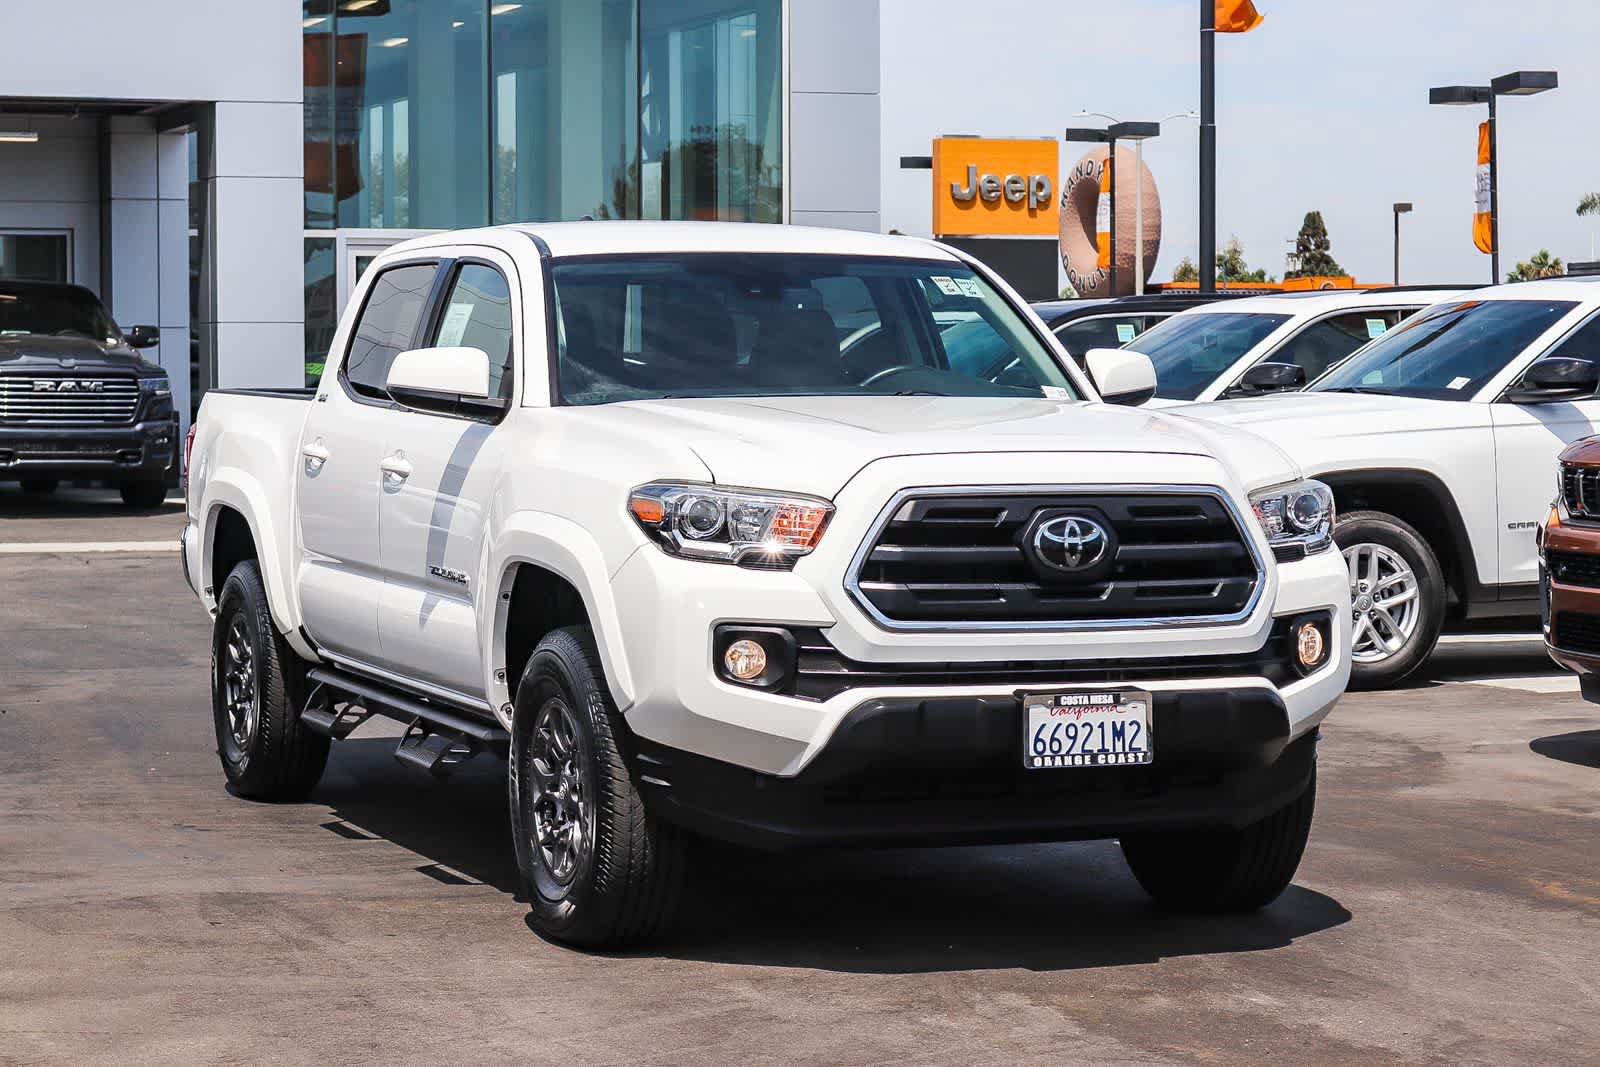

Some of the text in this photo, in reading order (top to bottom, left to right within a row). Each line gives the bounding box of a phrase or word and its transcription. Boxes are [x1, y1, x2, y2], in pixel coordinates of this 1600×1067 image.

[952, 164, 1051, 208] Jeep
[33, 381, 104, 391] RAM
[1060, 694, 1114, 706] COSTA MESA
[1033, 720, 1142, 756] 66921M2
[1033, 752, 1145, 767] ORANGE COAST
